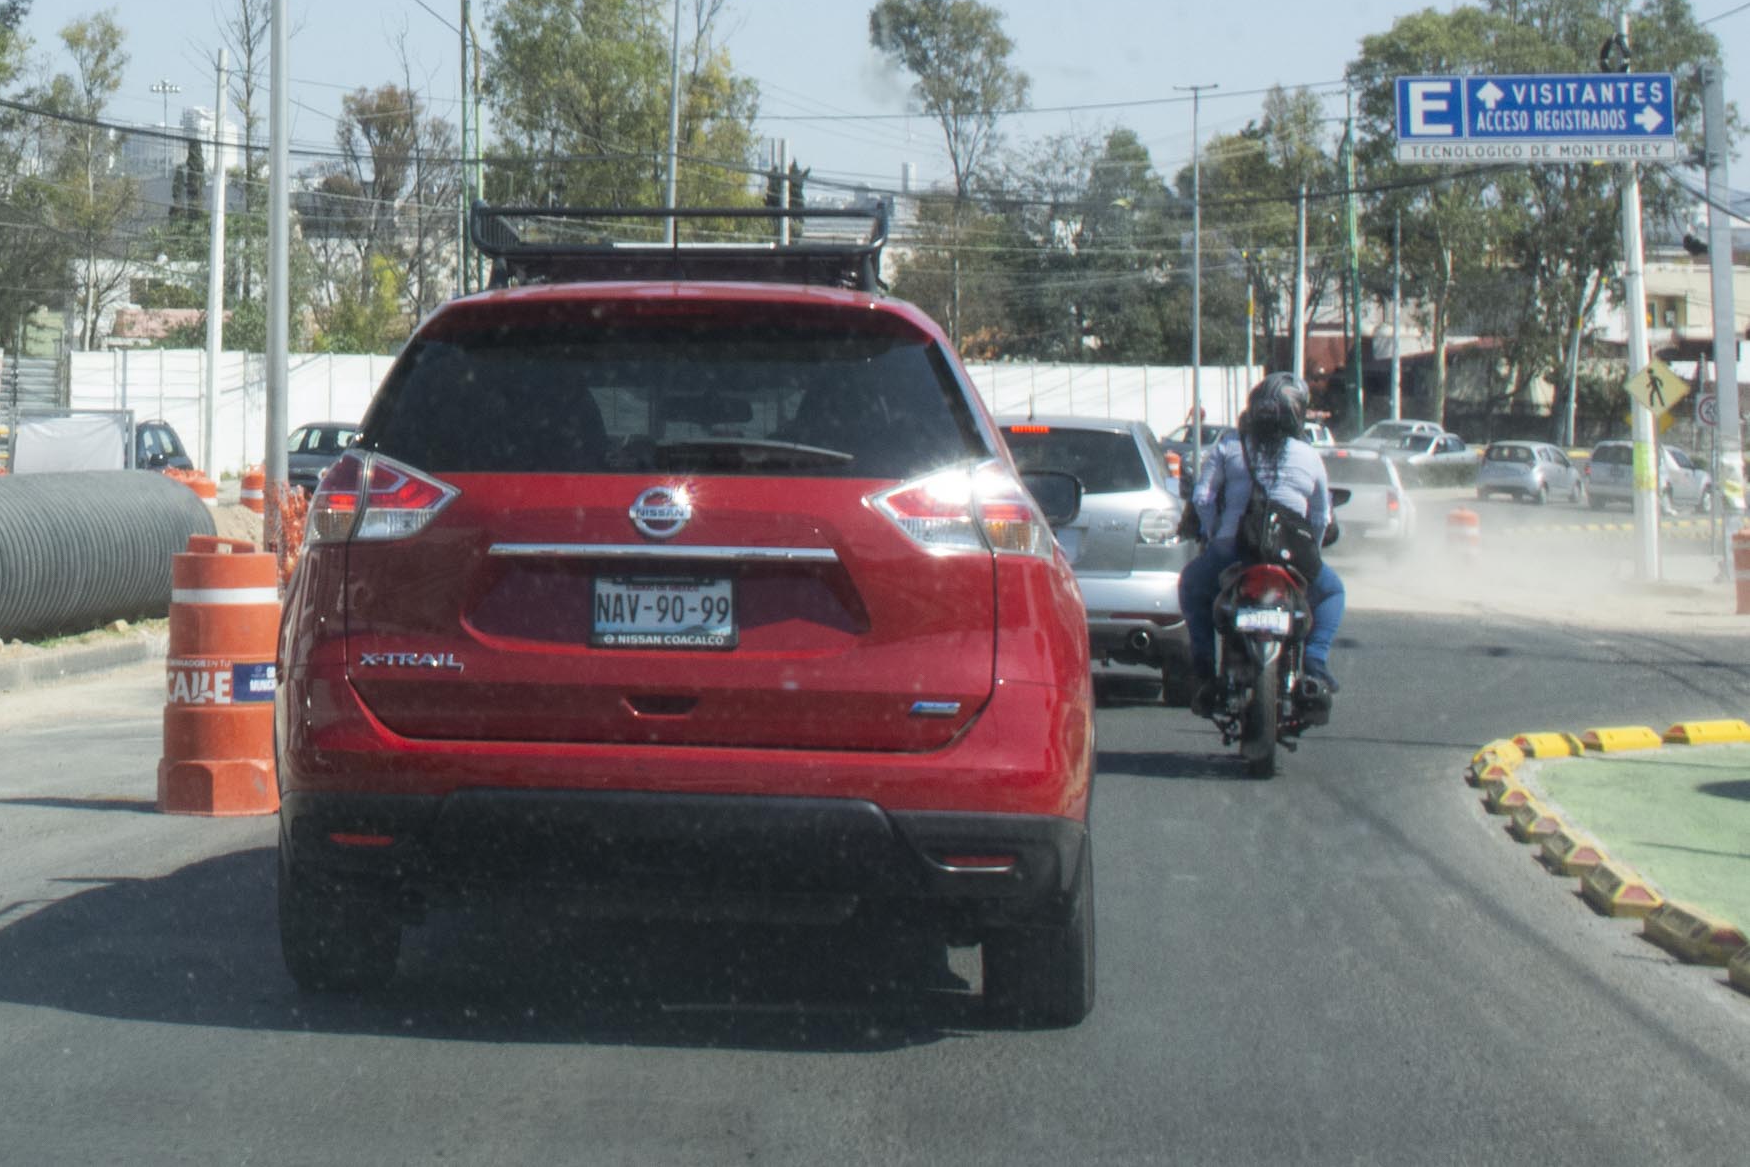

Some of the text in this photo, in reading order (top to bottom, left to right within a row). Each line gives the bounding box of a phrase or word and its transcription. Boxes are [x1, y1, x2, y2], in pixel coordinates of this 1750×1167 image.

[1512, 82, 1664, 106] VISITANTES
[1408, 81, 1453, 134] E
[1476, 109, 1627, 132] ACCESO REGISTRADOS
[1410, 143, 1663, 158] TECNOLOGICO DE MONTERREY
[636, 508, 684, 517] NISSAN
[597, 593, 730, 624] NAV-90-99
[618, 635, 725, 646] NISSAN COACALCO
[360, 652, 465, 674] X-TRAIL
